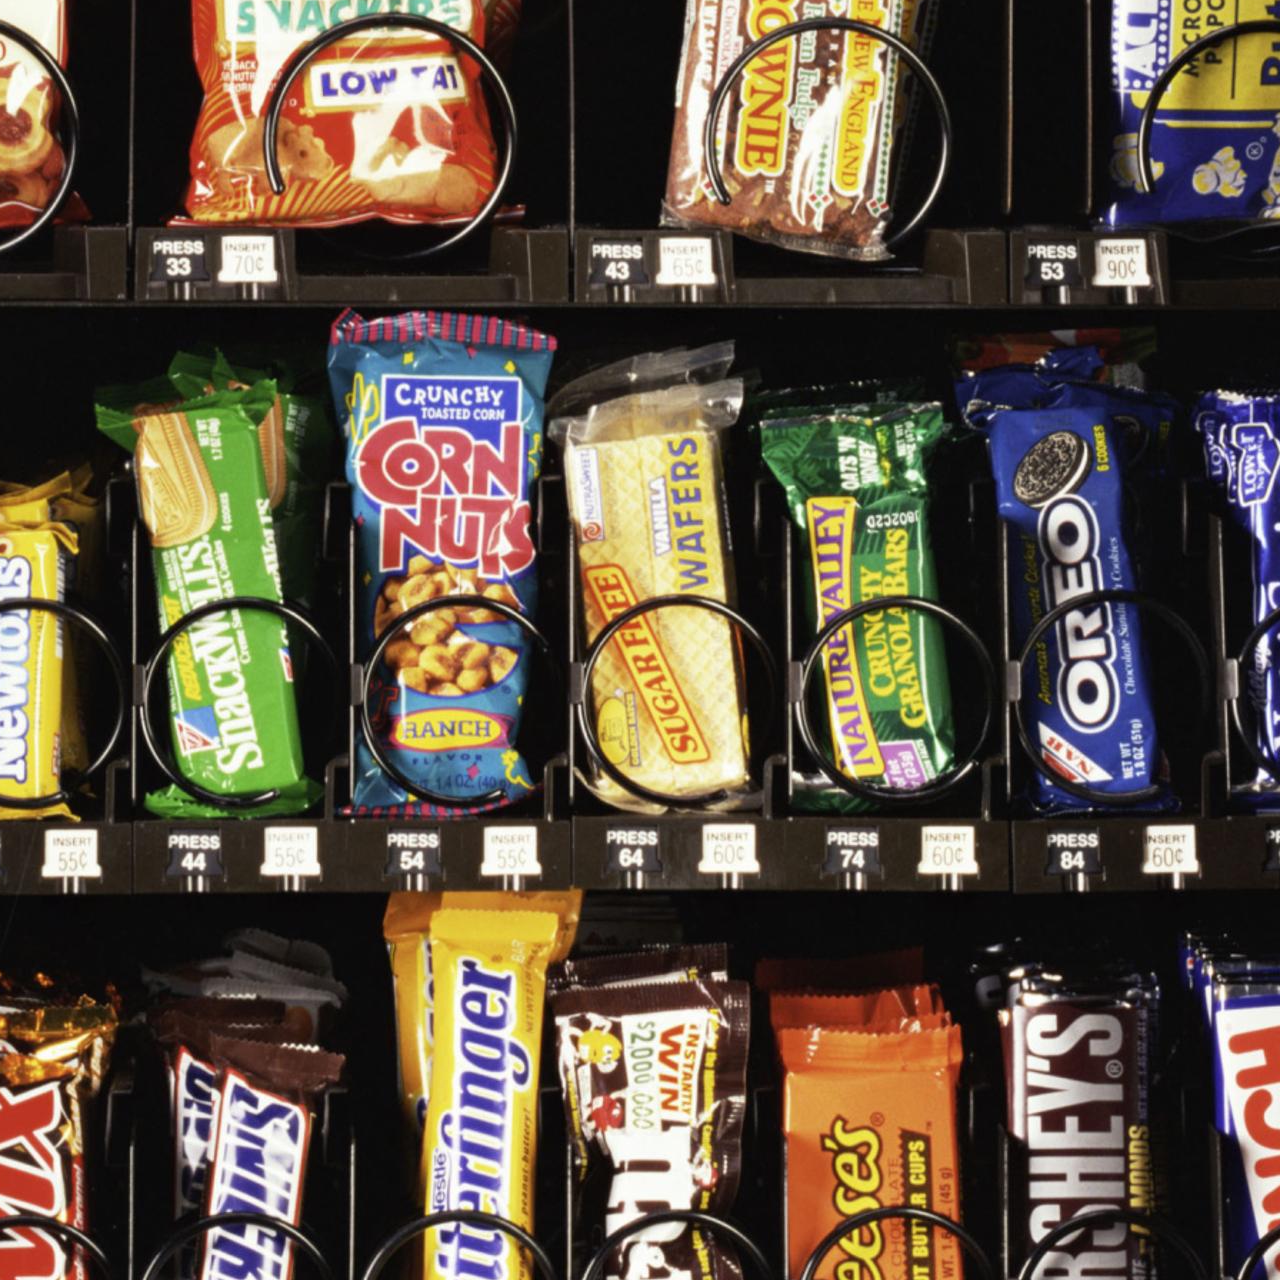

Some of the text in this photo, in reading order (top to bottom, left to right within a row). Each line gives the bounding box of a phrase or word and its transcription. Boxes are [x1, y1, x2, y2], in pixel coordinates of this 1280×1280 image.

[320, 70, 397, 98] LOW
[395, 384, 503, 405] CRUNCHY
[421, 408, 505, 420] TOASTED CORN
[357, 421, 521, 506] CORN
[1093, 426, 1110, 460] COOKIES
[380, 496, 535, 578] NUTS
[650, 476, 670, 556] VANILLA
[667, 438, 709, 590] WAFERS
[1045, 502, 1114, 728] OREO
[907, 1140, 925, 1187] CUPS
